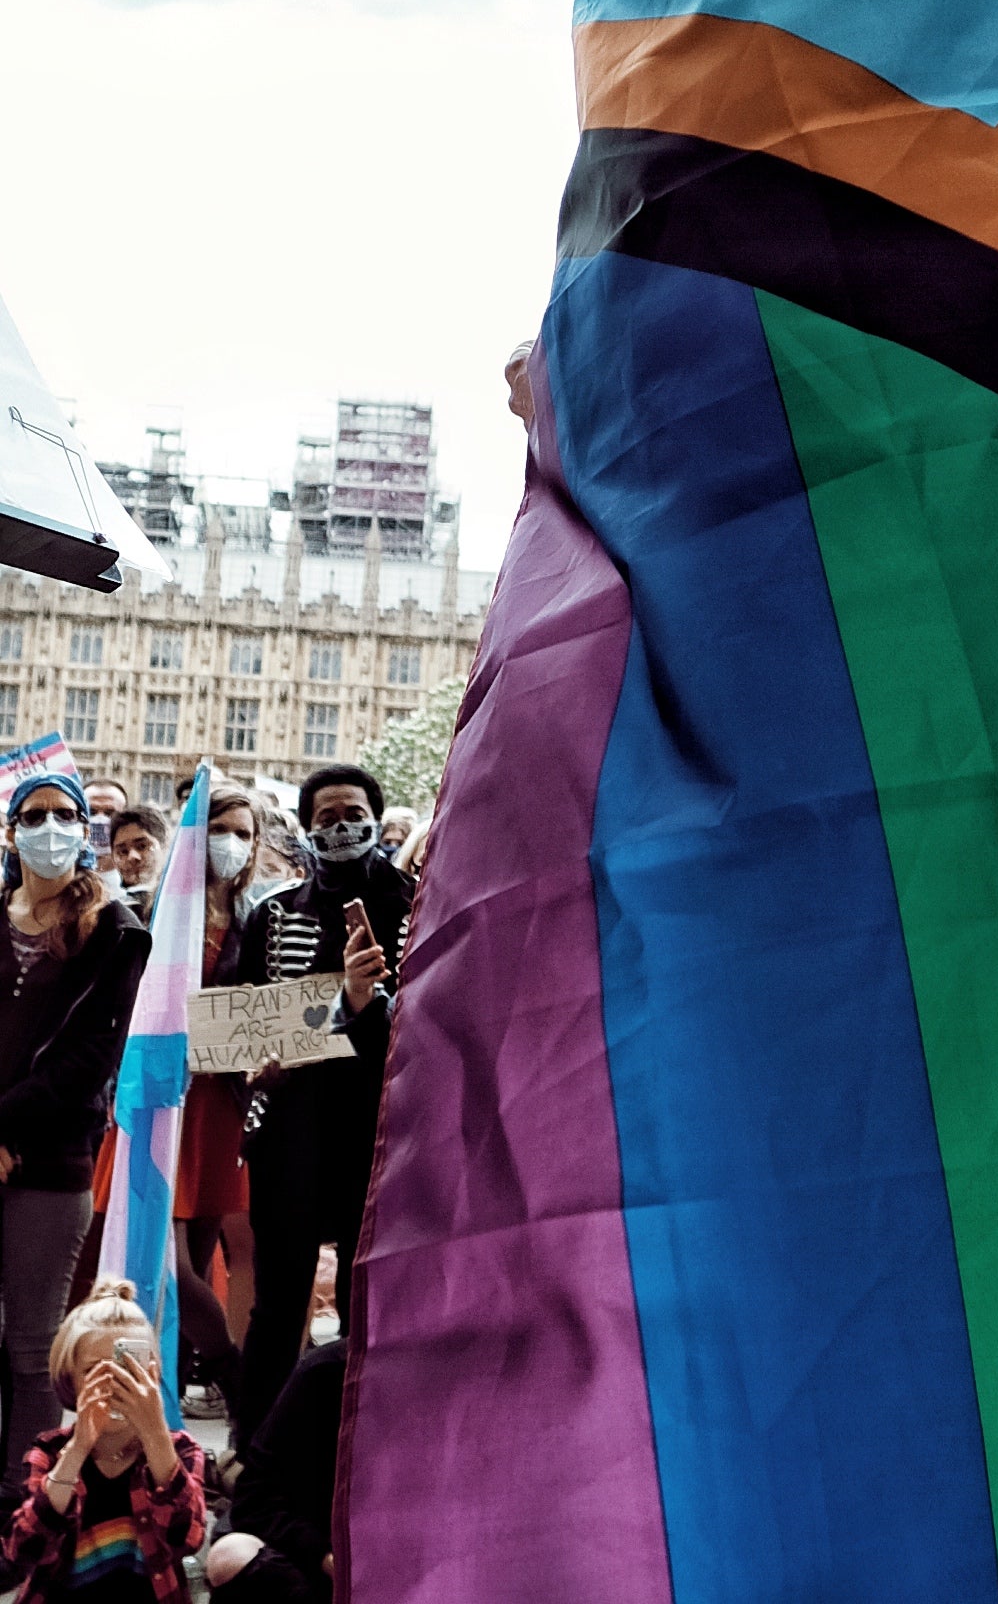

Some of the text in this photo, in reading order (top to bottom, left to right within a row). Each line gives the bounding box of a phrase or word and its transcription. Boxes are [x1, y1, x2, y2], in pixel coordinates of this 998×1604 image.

[7, 753, 46, 772] WILL
[199, 989, 292, 1019] TRANS
[228, 1016, 285, 1043] ARE
[194, 1040, 284, 1071] HUMAN
